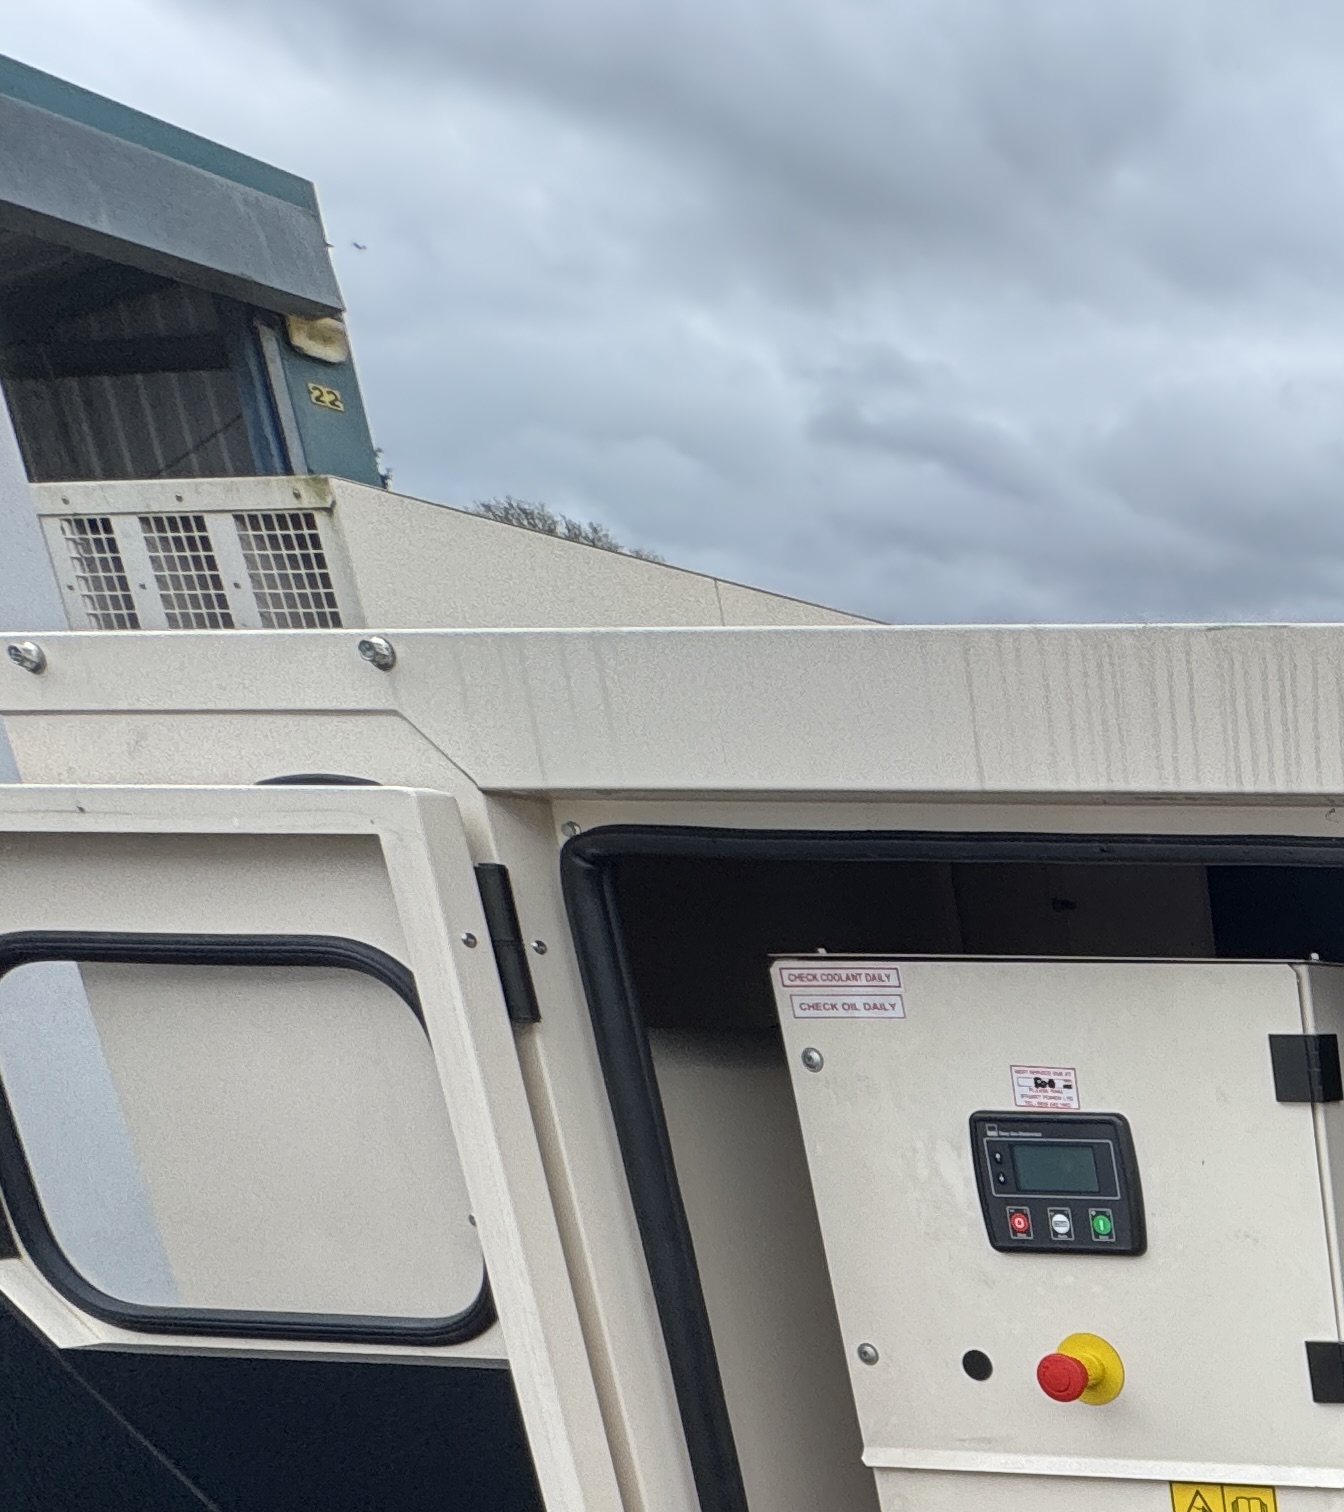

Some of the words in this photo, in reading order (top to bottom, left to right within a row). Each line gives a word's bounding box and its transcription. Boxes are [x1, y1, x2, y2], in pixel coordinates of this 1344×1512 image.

[311, 386, 342, 409] 22
[788, 972, 819, 983] CHECK
[820, 973, 862, 983] COOLANT
[864, 972, 891, 983] DAILY
[799, 1002, 839, 1012] CHECK
[841, 1002, 861, 1012] OIL
[863, 1002, 897, 1012] DAILY
